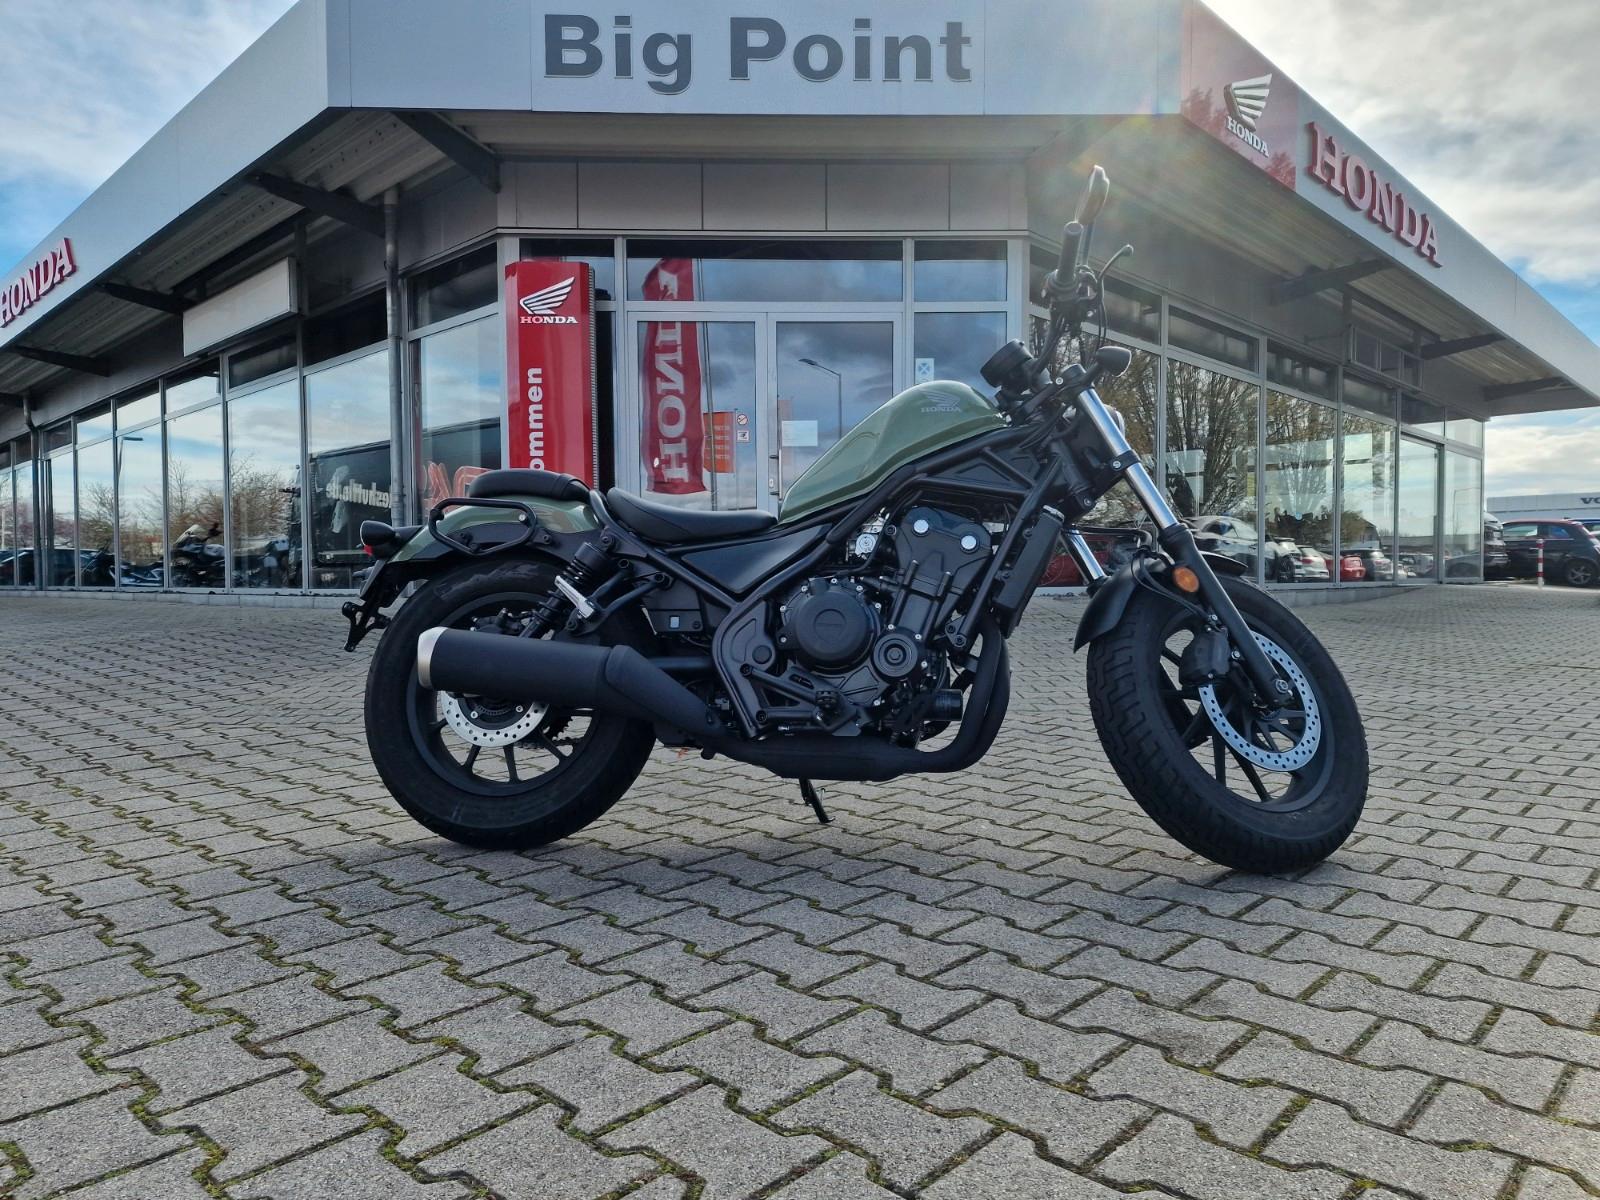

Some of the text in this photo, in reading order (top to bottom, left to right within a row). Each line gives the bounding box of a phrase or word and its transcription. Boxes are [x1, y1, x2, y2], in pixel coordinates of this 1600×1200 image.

[544, 14, 972, 96] Big Point
[1227, 116, 1269, 158] HONDA
[1306, 121, 1442, 268] HONDA
[0, 237, 77, 328] HONDA
[519, 316, 578, 324] HONDA
[920, 406, 963, 414] HONDA
